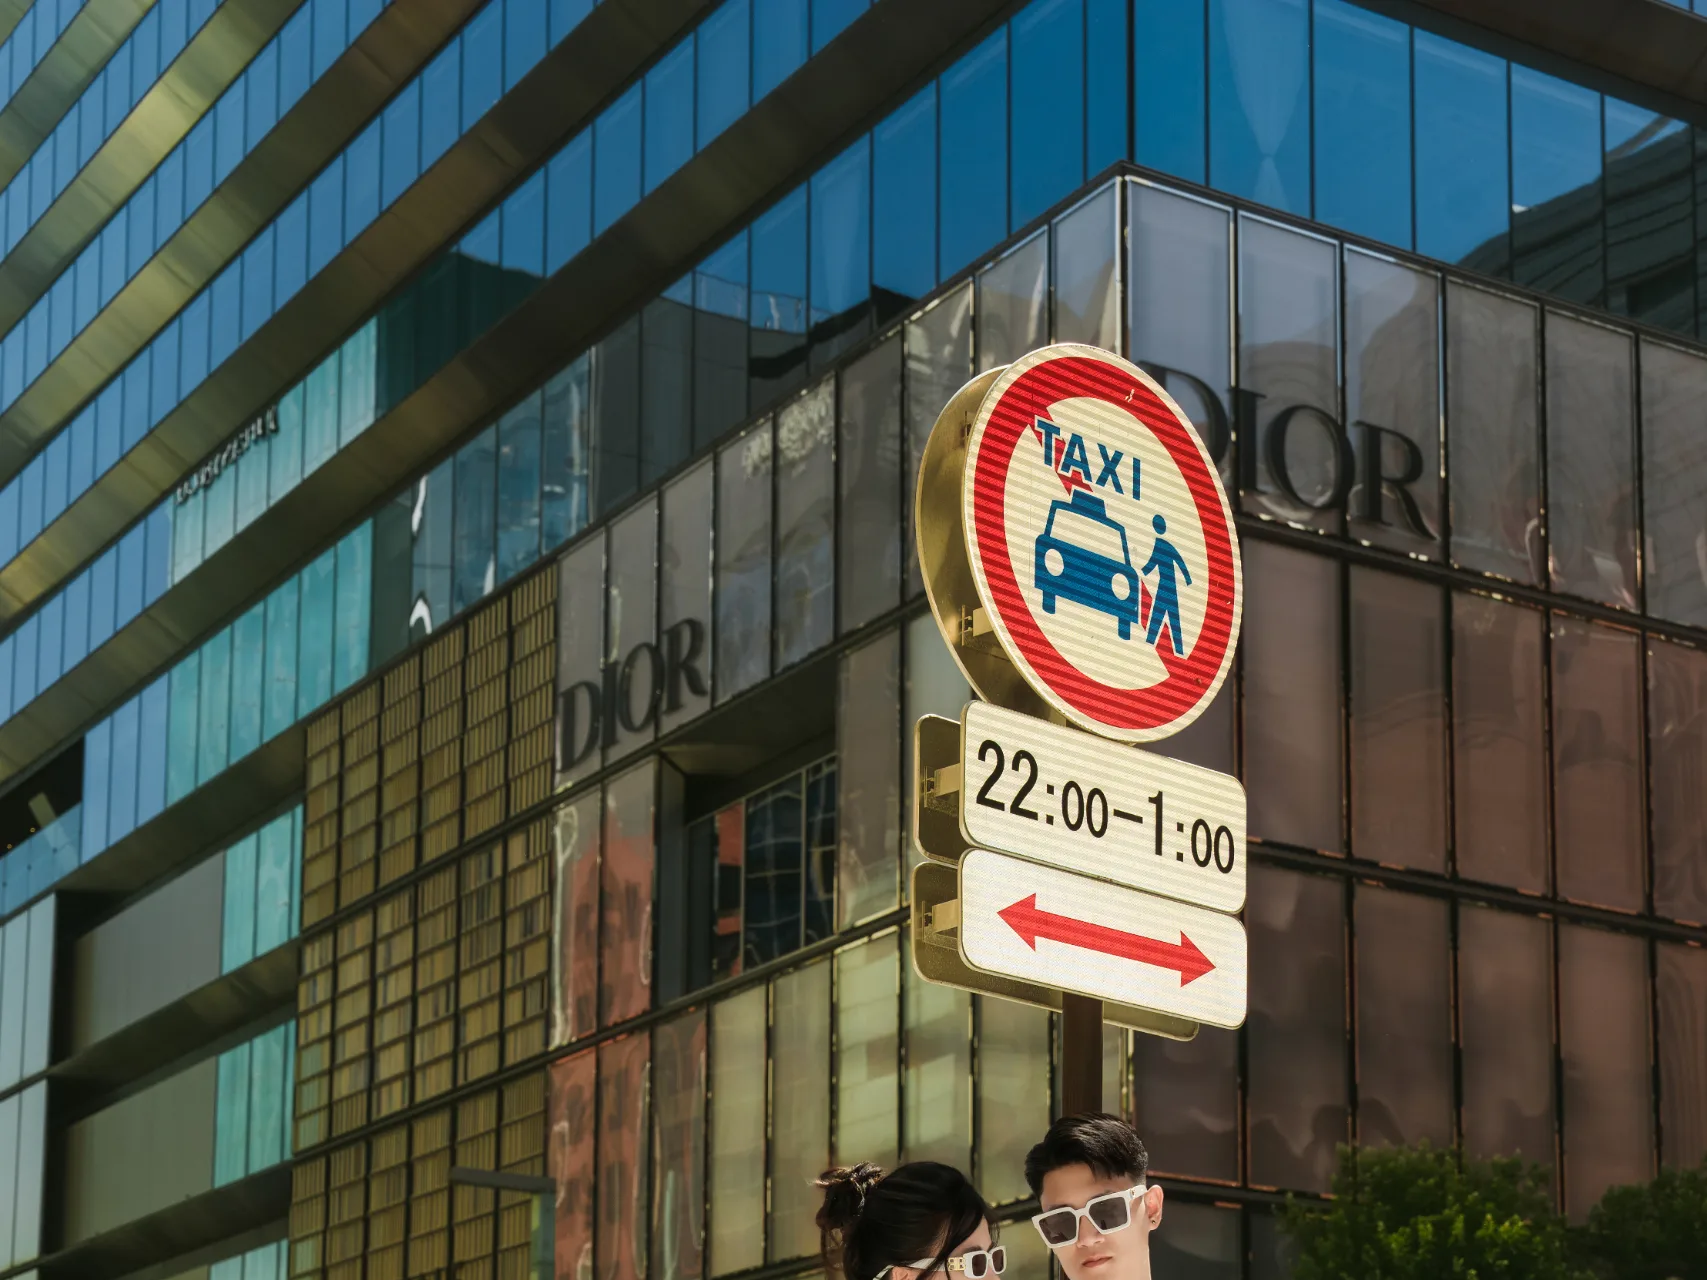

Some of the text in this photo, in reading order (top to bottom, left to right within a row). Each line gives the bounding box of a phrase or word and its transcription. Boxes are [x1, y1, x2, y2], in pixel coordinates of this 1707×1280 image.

[1037, 418, 1141, 501] TAXI
[1137, 360, 1438, 541] DIOR
[558, 617, 708, 774] DIOR
